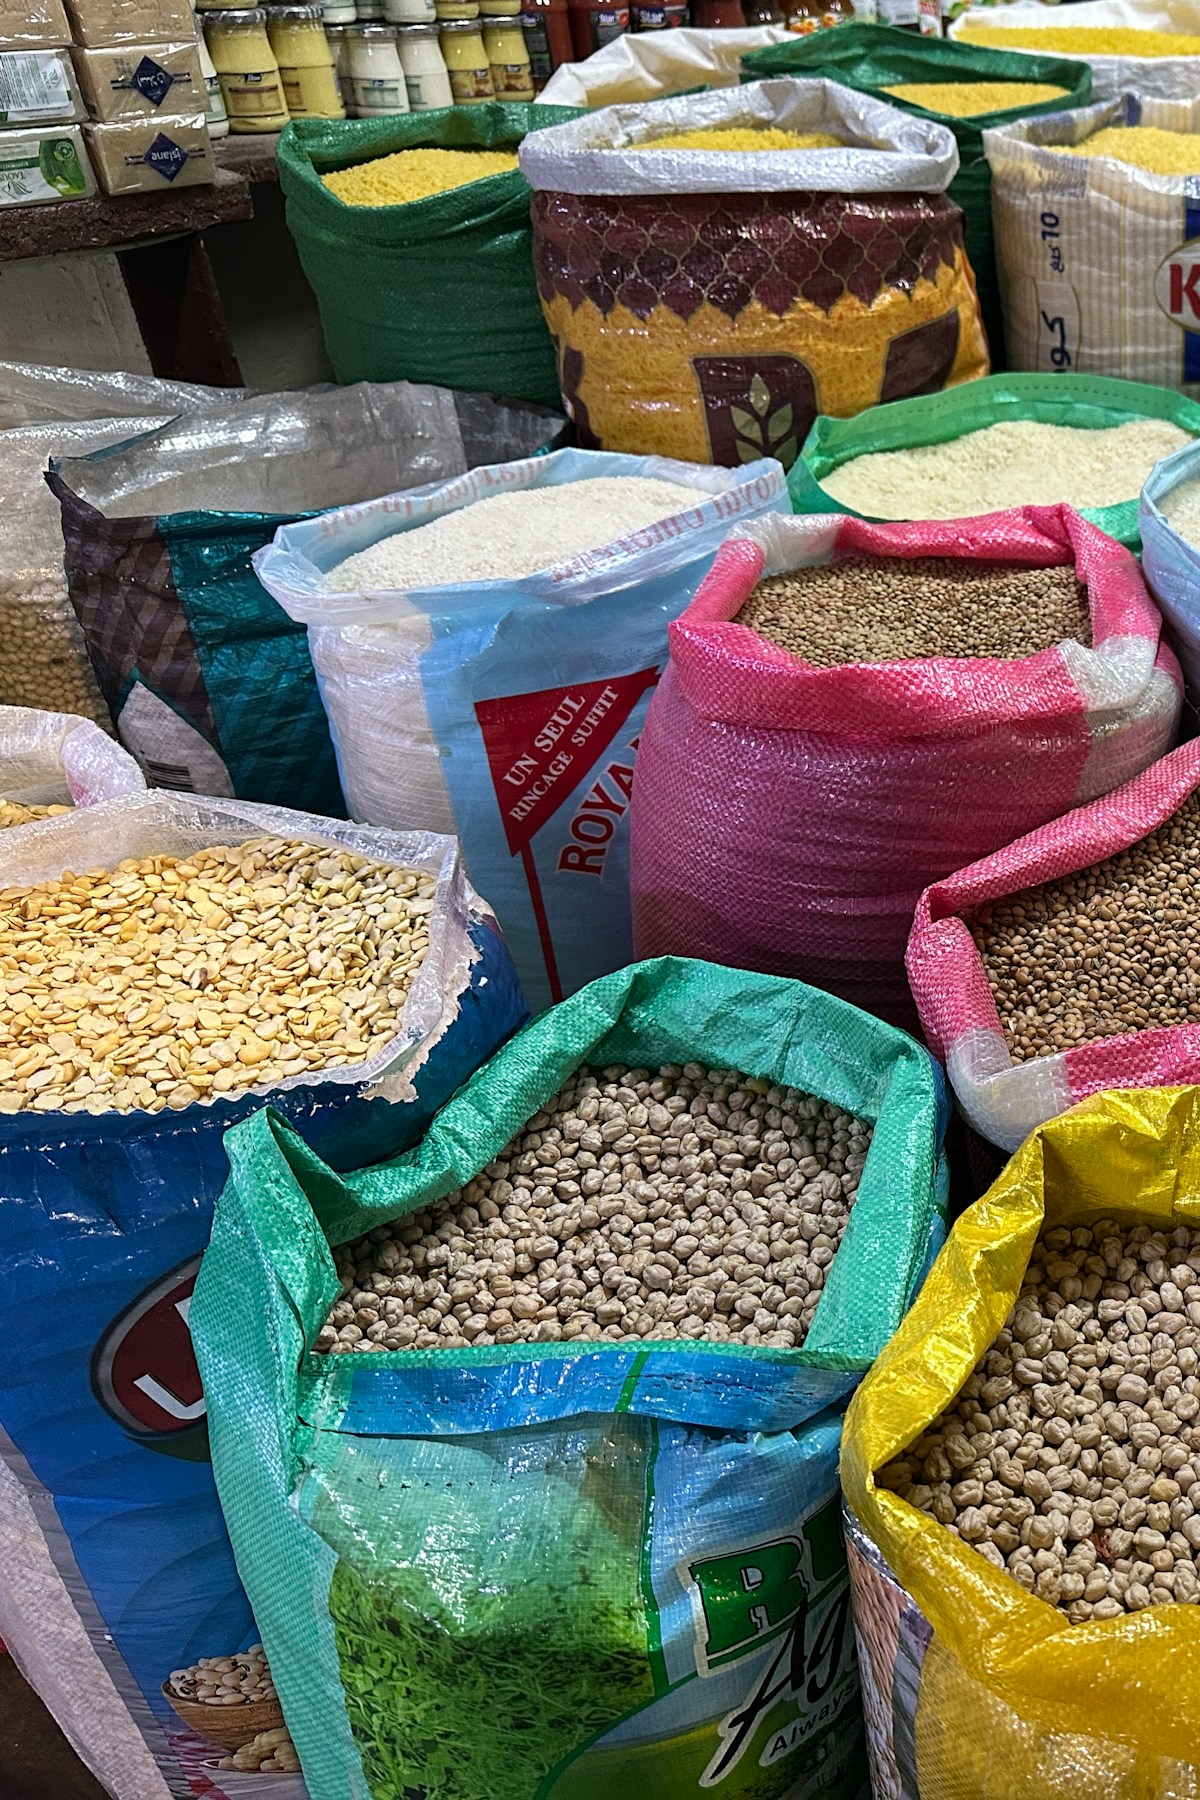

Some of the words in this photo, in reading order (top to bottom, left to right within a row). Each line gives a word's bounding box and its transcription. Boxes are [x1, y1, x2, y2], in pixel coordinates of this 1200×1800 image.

[150, 147, 182, 161] islane
[1040, 211, 1061, 242] 10
[503, 752, 540, 787] UN
[534, 694, 586, 753] SEUL
[508, 750, 574, 822] RINCAGE
[570, 685, 619, 747] SUFFIT
[555, 735, 641, 882] ROYA
[768, 1681, 854, 1759] Always
